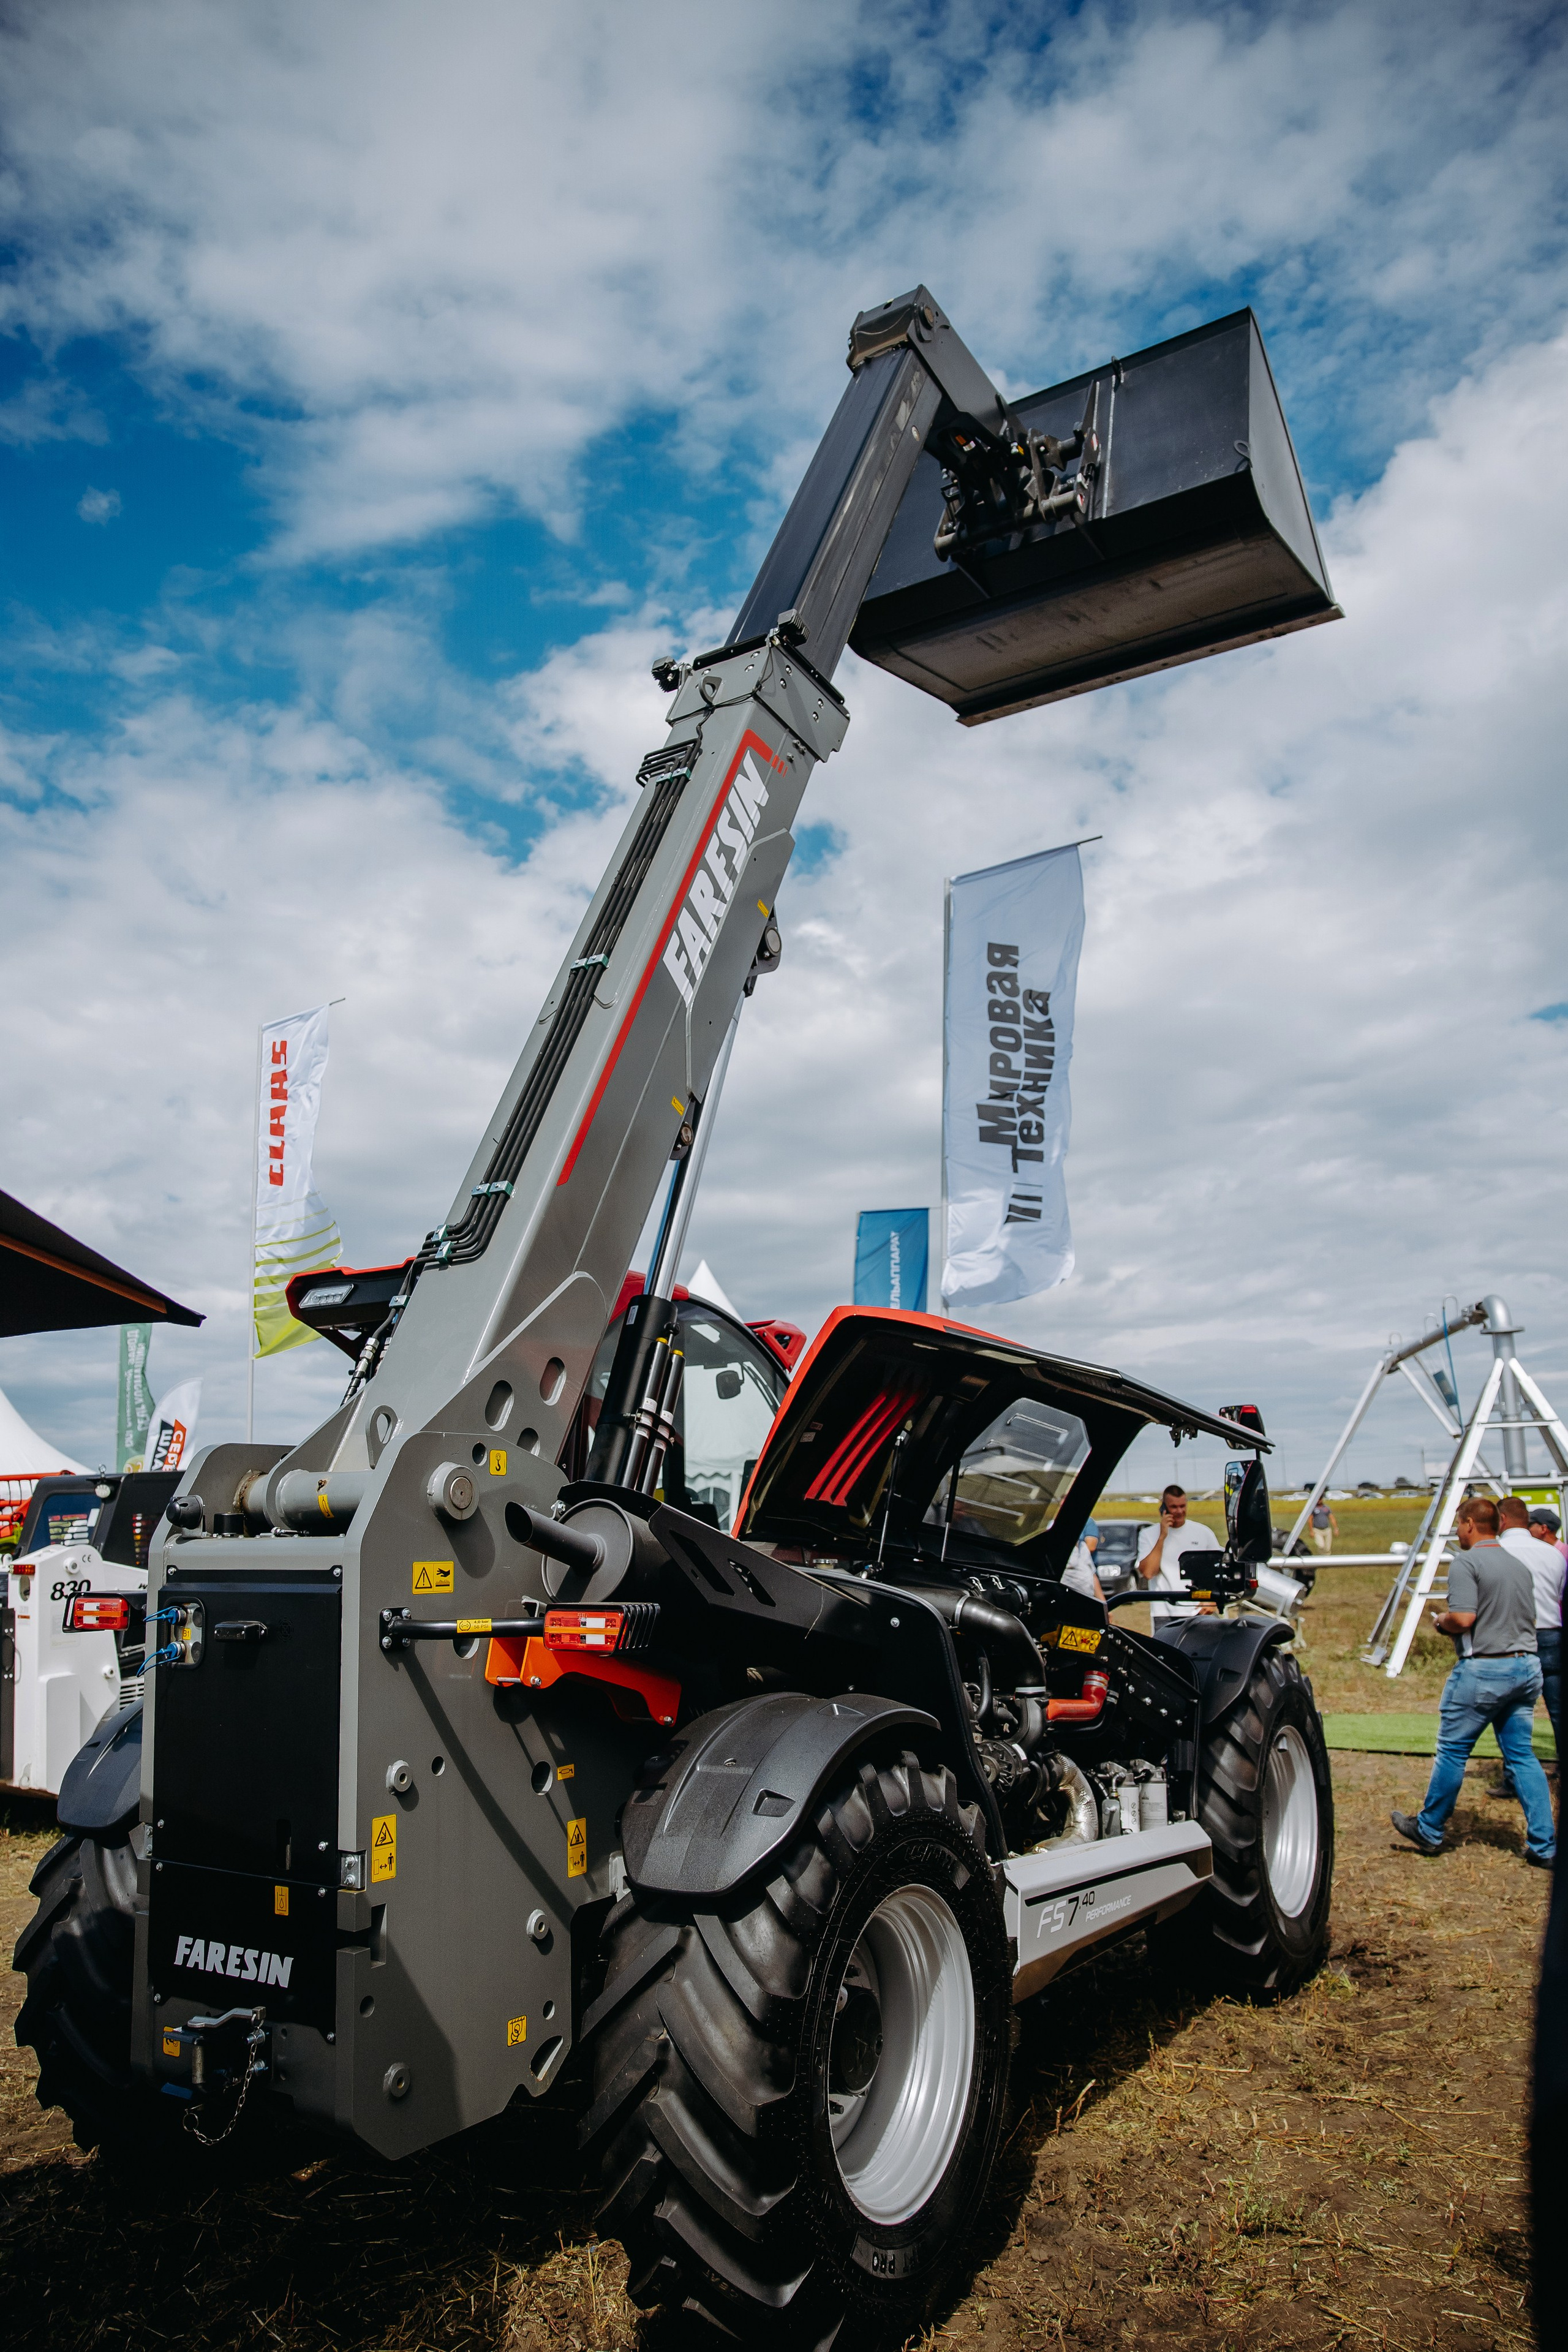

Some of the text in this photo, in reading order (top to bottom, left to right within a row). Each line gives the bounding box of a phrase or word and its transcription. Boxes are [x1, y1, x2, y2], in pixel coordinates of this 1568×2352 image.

[662, 750, 769, 1008] FARESIN
[269, 1040, 288, 1186] CLAAS
[976, 941, 1022, 1145] Мировая
[1011, 988, 1055, 1174] Техника
[50, 1579, 91, 1600] 830
[173, 1935, 294, 1988] FARESIN
[1085, 1894, 1132, 1923] PERFORMANCE
